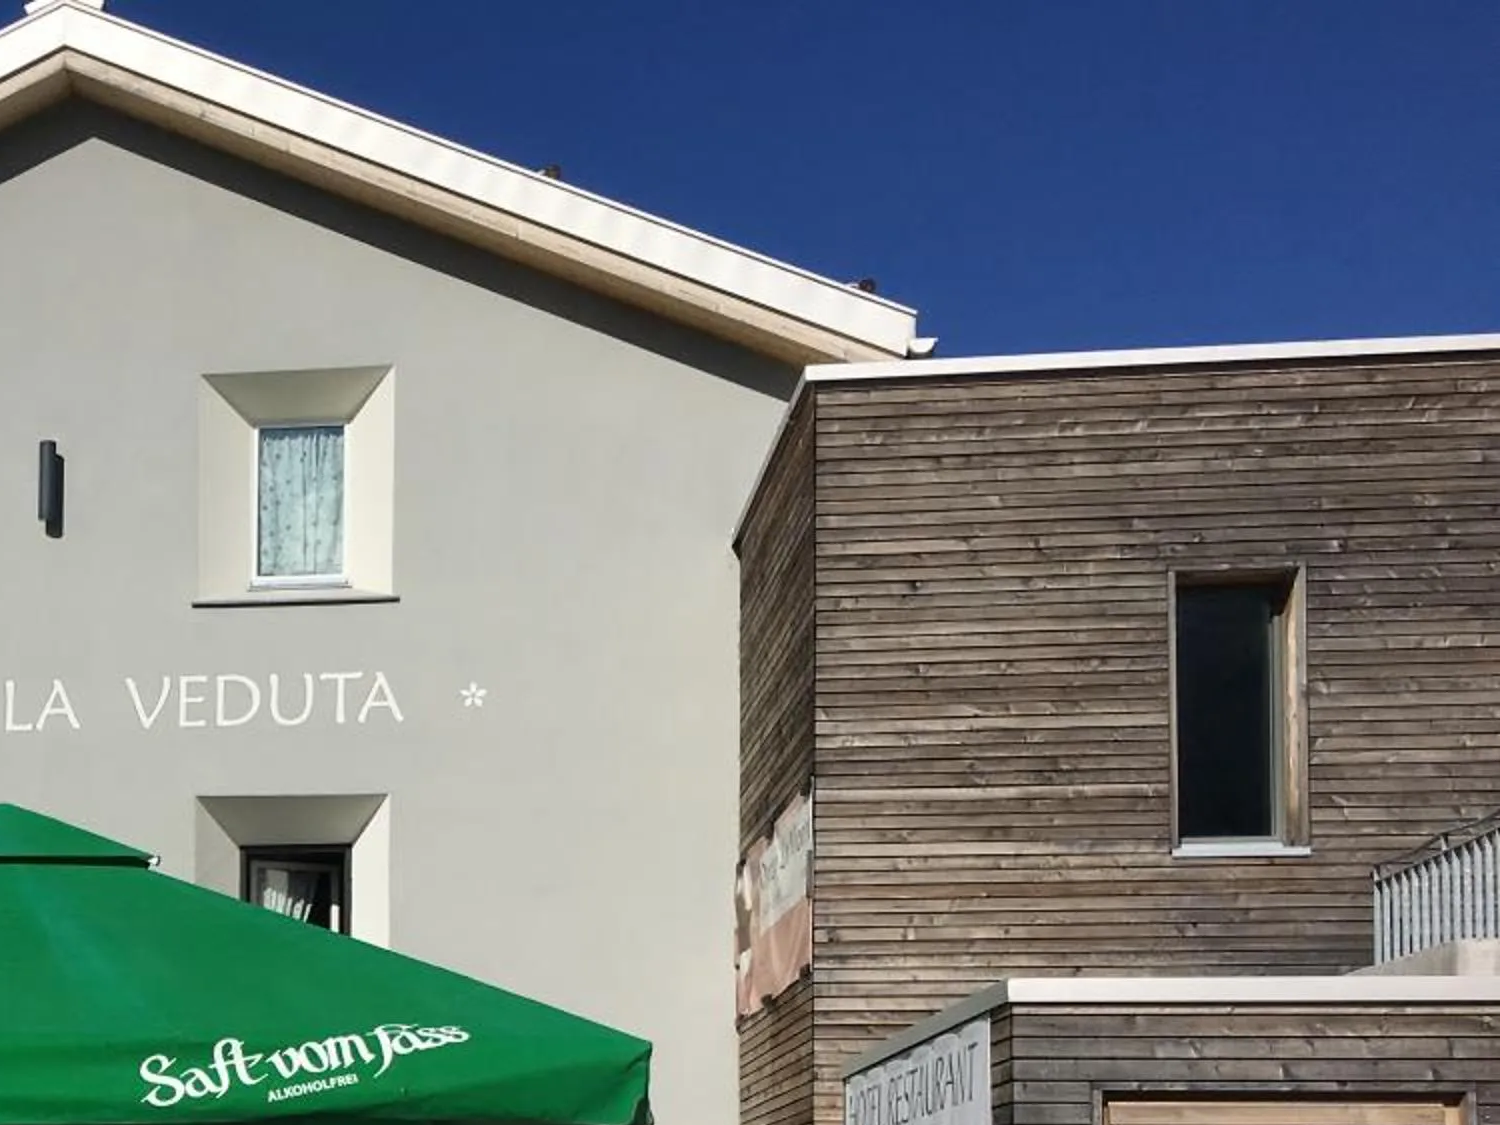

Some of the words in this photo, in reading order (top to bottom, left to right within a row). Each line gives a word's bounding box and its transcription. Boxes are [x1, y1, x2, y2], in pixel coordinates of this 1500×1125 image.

[5, 679, 81, 731] LA
[126, 672, 405, 730] VEDUTA
[140, 1037, 268, 1107] Saft
[266, 1033, 376, 1078] vom
[267, 1074, 359, 1102] ALKOHOLFREI
